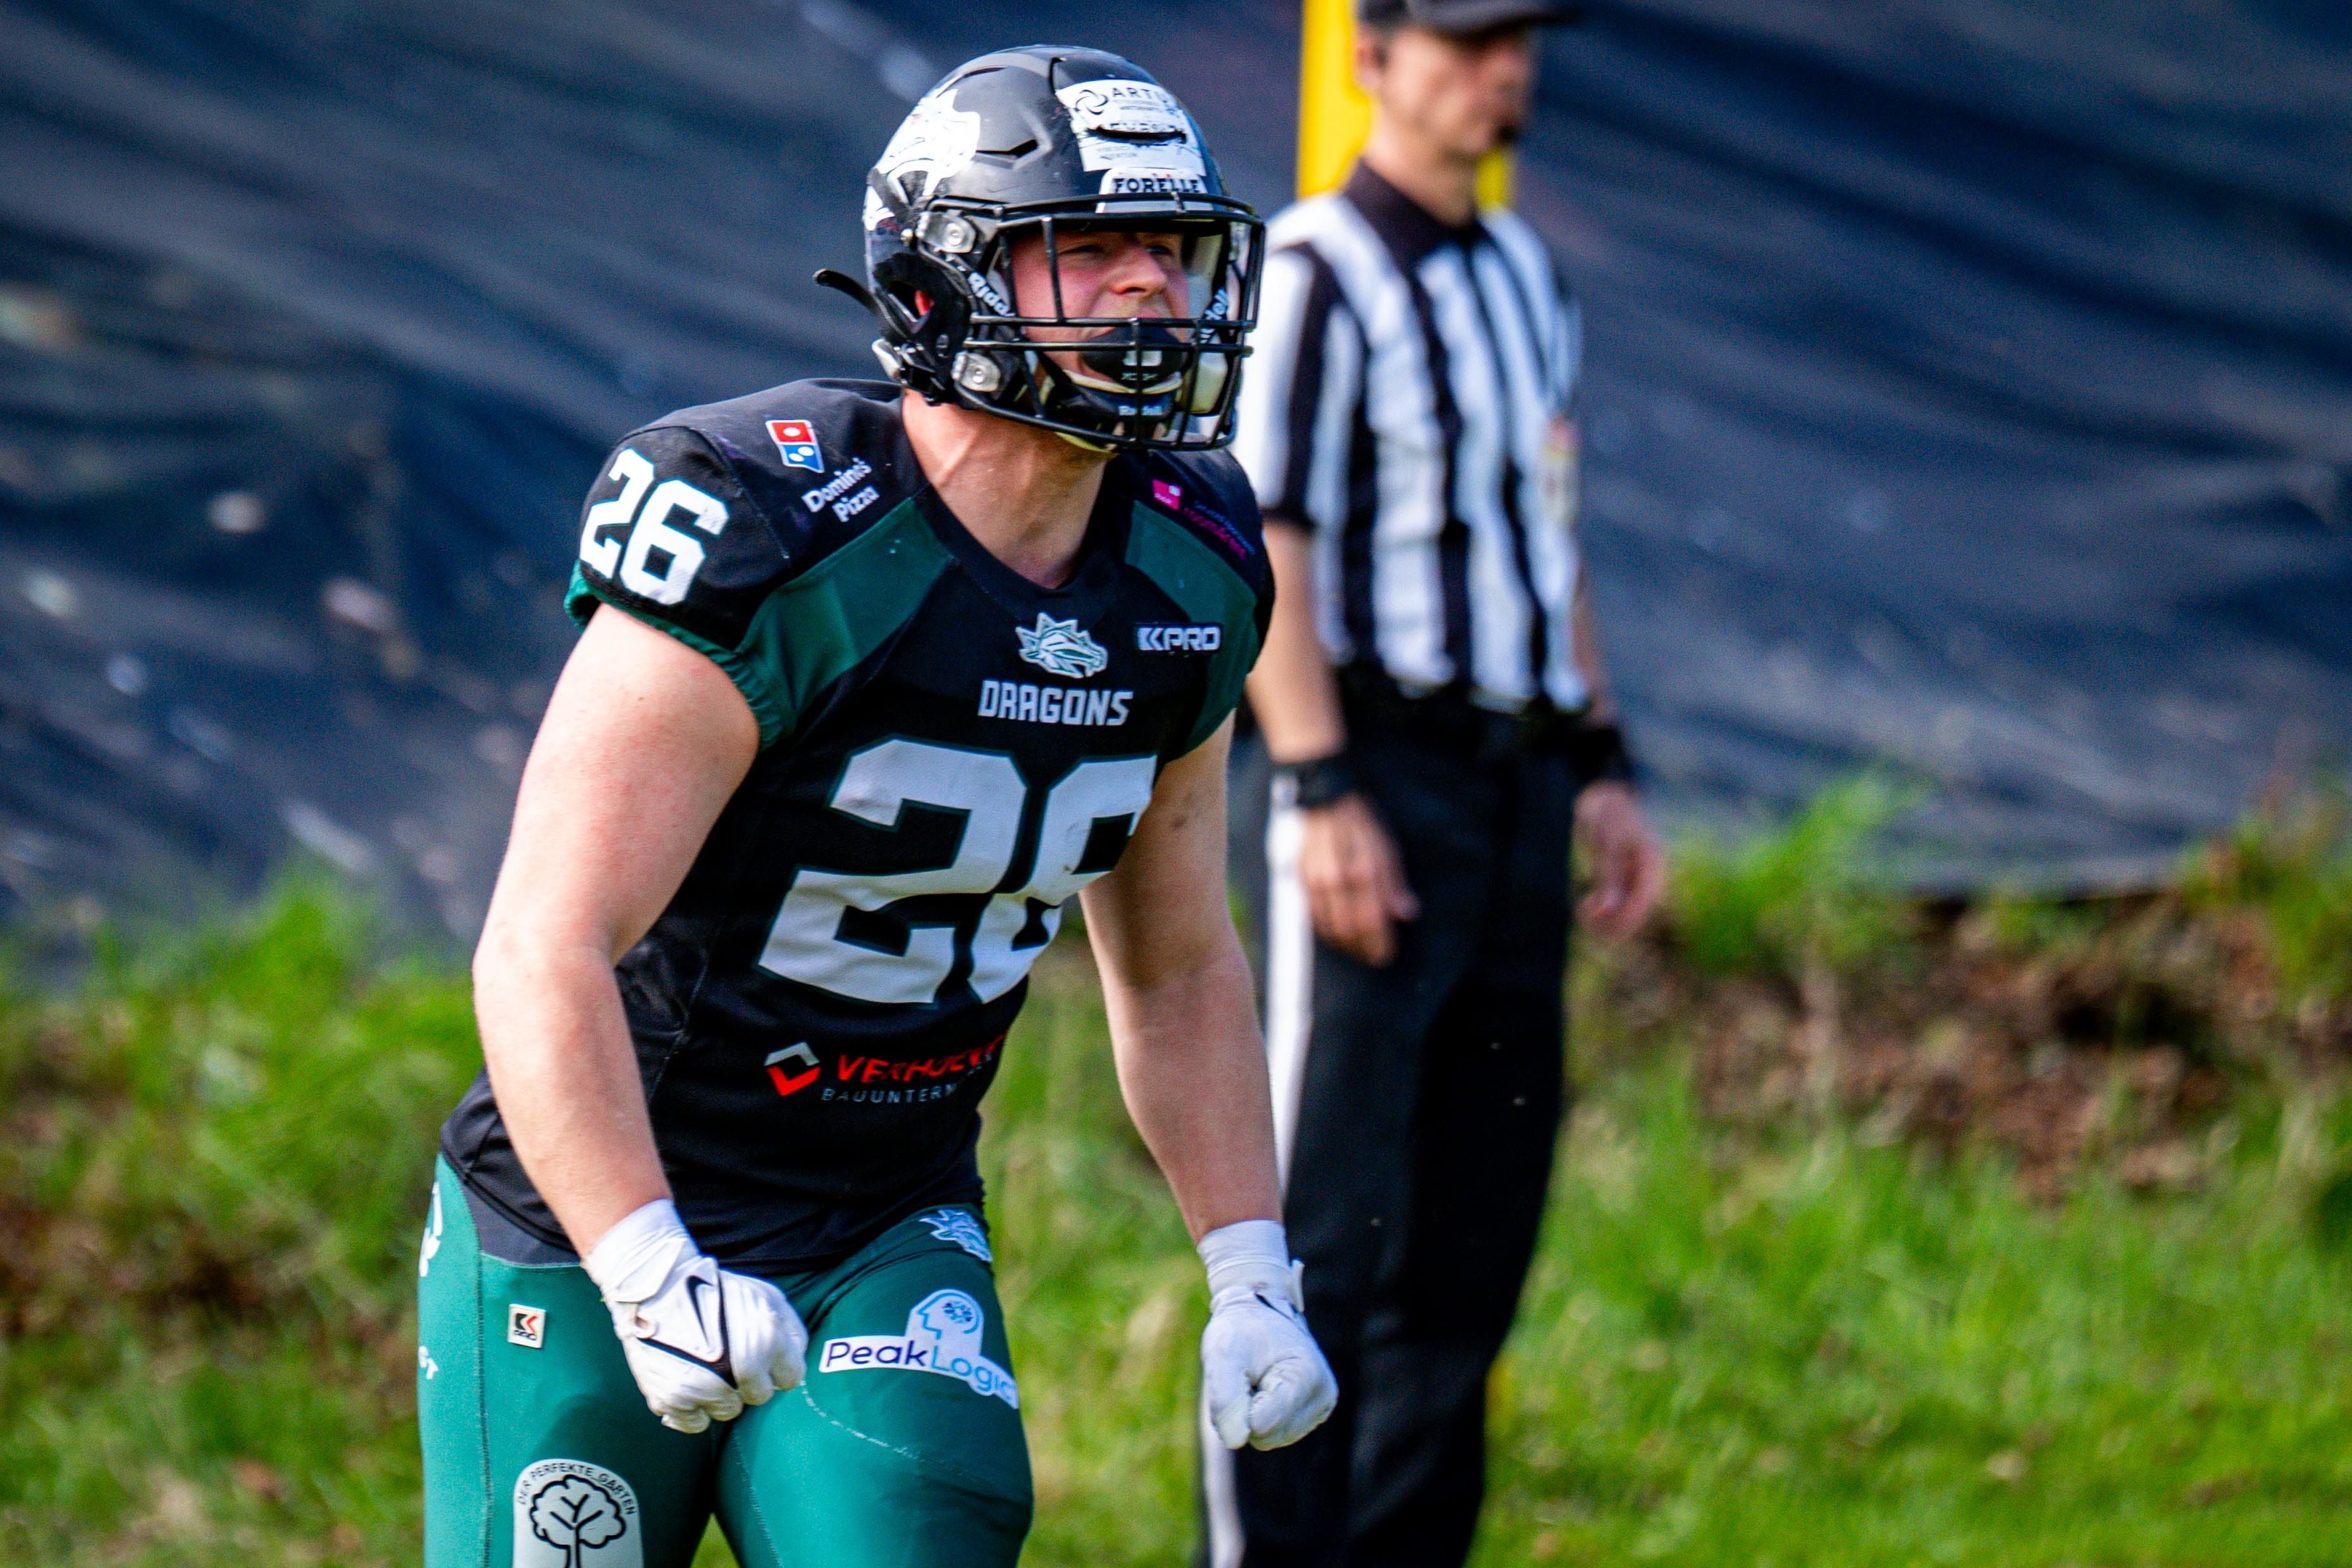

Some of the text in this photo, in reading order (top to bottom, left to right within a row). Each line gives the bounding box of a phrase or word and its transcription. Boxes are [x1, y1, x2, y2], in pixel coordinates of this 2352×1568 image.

[1113, 178, 1201, 194] FORELLE
[801, 457, 872, 513] Domino's
[831, 485, 880, 522] Pizza
[578, 447, 729, 605] 26
[977, 679, 1134, 726] DRAGONS
[757, 736, 1158, 1006] 26
[518, 1462, 636, 1516] DER PERFEKTE GARTEN
